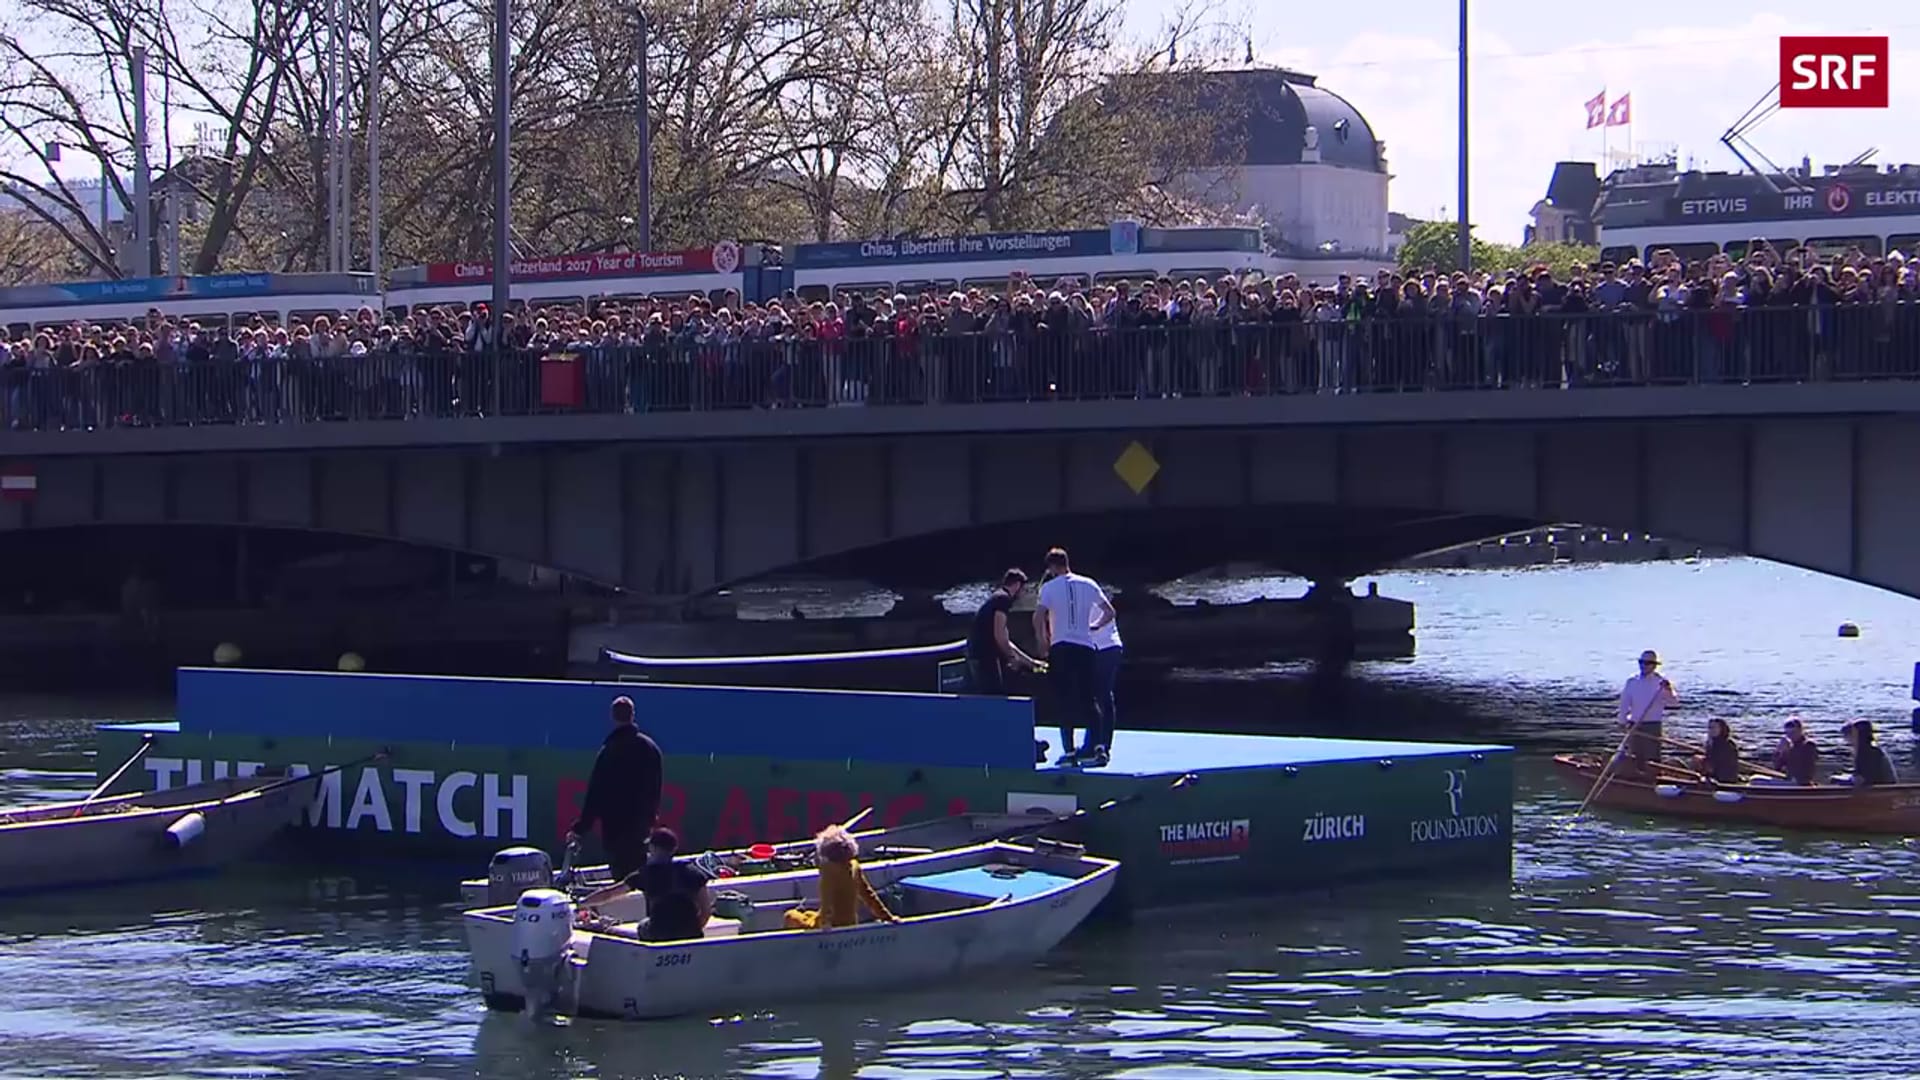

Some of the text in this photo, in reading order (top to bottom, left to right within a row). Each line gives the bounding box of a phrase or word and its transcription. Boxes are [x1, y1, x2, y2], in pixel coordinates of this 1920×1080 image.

[1681, 190, 1920, 214] ETAVIS IHR ELEKT
[861, 234, 1071, 257] China, übertrifft Ihre Vorstellungen
[454, 262, 485, 277] China
[510, 259, 561, 275] witzerland
[567, 261, 590, 273] 2017
[596, 256, 621, 271] Year
[624, 254, 636, 268] of
[640, 252, 683, 269] Tourism
[288, 763, 528, 839] MATCH
[556, 779, 687, 846] FR
[714, 785, 969, 846] AFRIC
[1160, 824, 1184, 842] THE
[1186, 820, 1230, 841] MATCH
[1303, 811, 1364, 841] ZÜRICH
[1411, 814, 1498, 842] FOUNDATION
